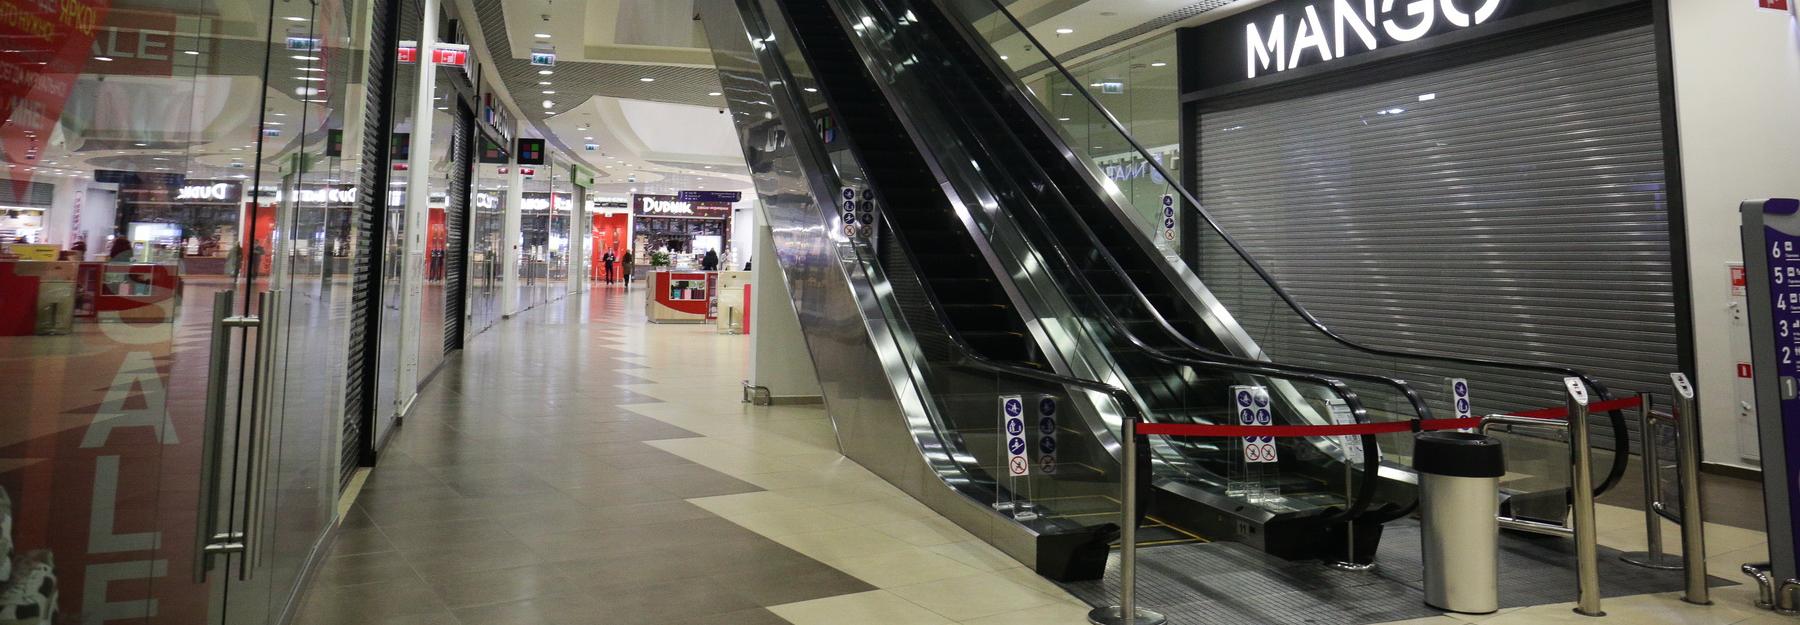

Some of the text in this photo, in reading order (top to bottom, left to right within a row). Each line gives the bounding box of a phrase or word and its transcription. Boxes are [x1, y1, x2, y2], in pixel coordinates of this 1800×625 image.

[1246, 0, 1502, 79] MANGO
[1772, 241, 1781, 258] 6
[1774, 267, 1784, 284] 5
[1777, 293, 1787, 311] 4
[1780, 319, 1789, 337] 3
[1782, 346, 1792, 364] 2
[1786, 379, 1793, 397] 1
